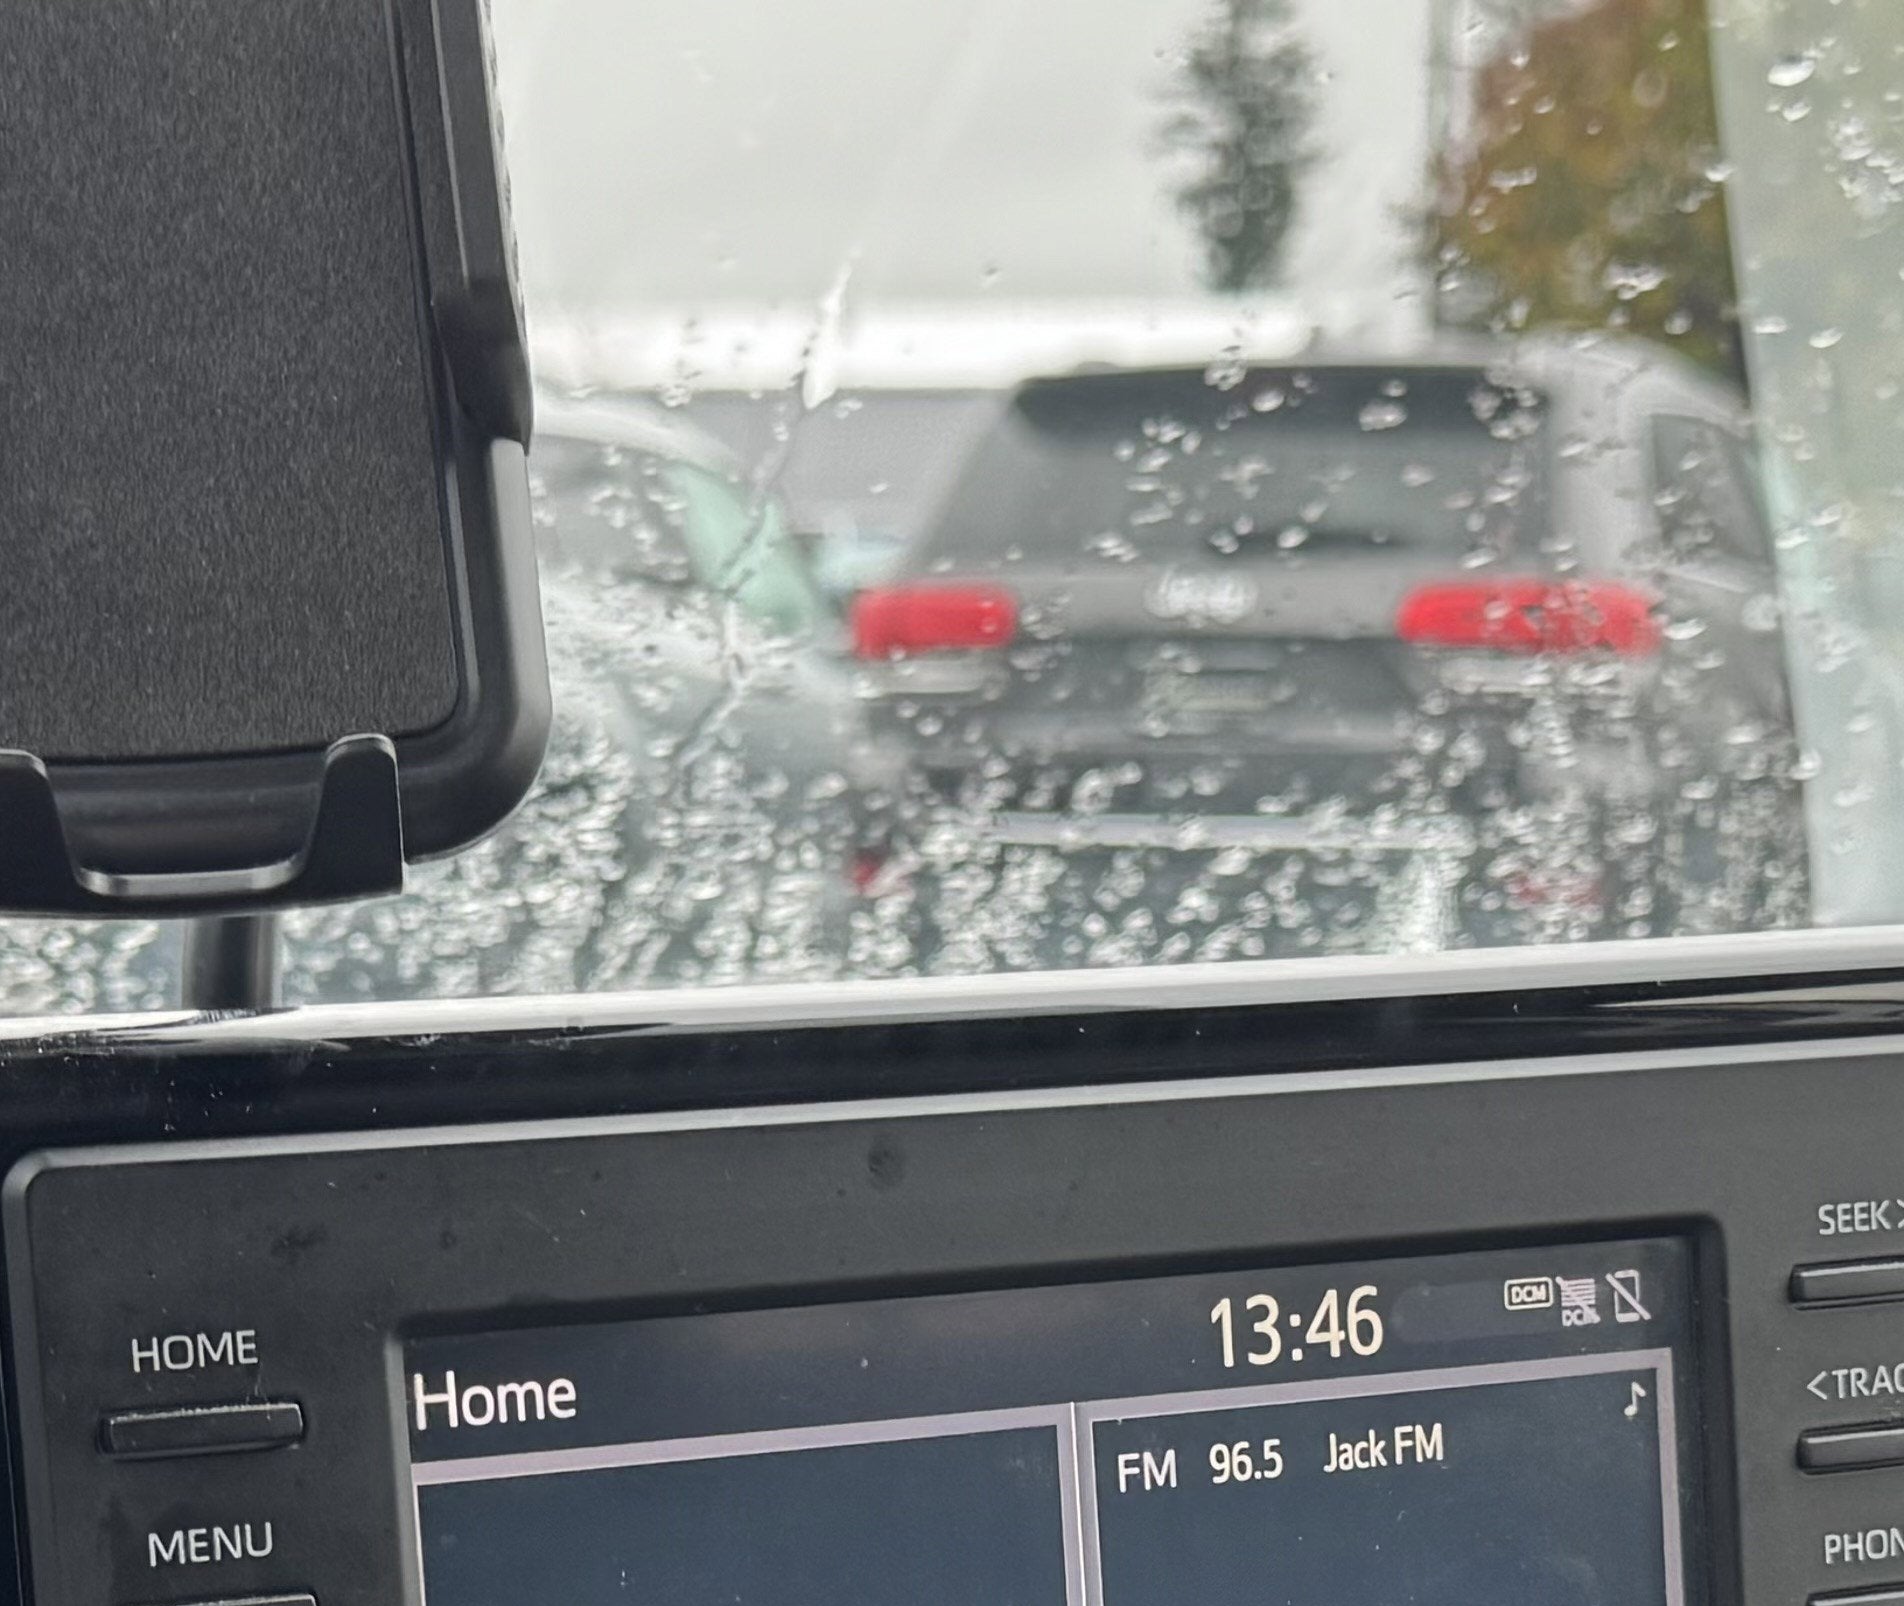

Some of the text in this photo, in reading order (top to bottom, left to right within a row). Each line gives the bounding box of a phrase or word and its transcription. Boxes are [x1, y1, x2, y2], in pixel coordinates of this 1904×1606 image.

[131, 1329, 259, 1373] HOME
[1210, 1285, 1384, 1368] 13:46
[413, 1369, 578, 1431] Home
[1117, 1422, 1445, 1493] FM 96.5 Jack FM
[147, 1521, 274, 1567] MENU
